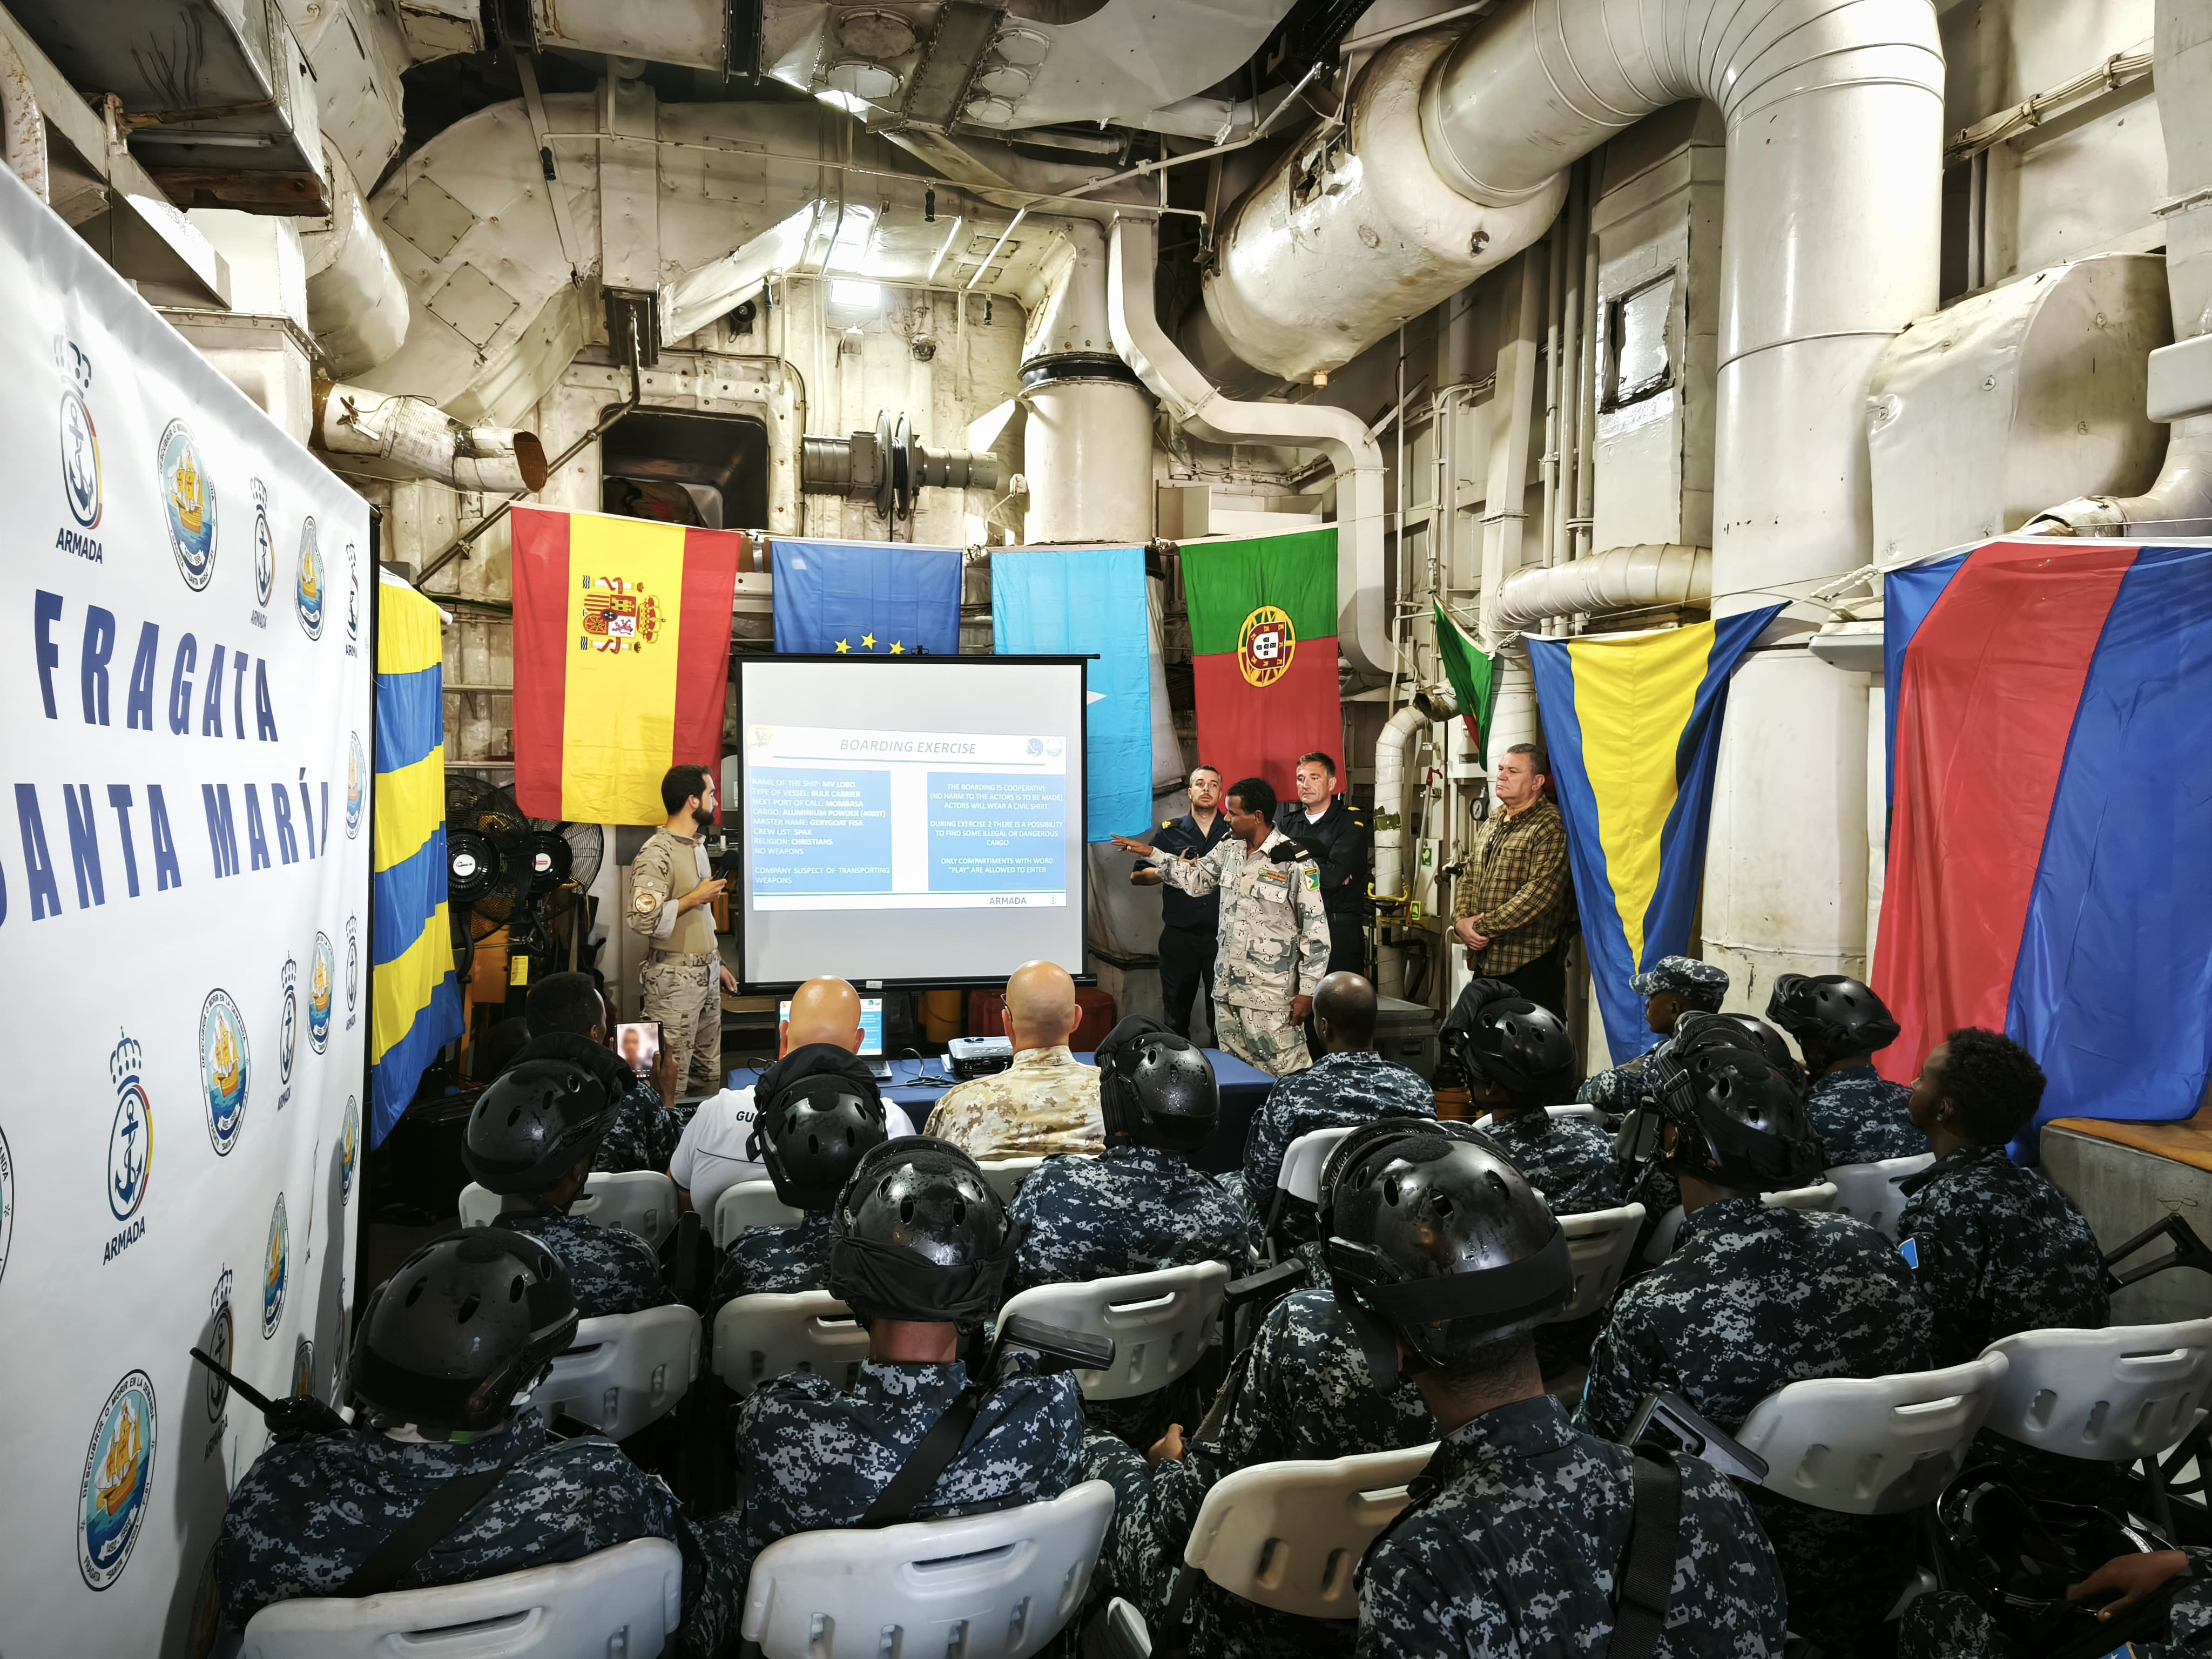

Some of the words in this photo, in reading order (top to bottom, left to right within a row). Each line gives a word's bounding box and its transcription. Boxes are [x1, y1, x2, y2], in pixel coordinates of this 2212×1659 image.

[56, 527, 103, 564] ARMADA
[250, 609, 267, 631] ARMADA
[34, 589, 279, 742] FRAGATA
[840, 739, 913, 753] BOARDING
[917, 741, 977, 754] EXERCISE
[0, 783, 182, 928] ANTA
[989, 897, 1027, 905] ARMADA
[103, 1216, 145, 1266] ARMADA
[82, 1420, 104, 1498] DESCUBRIR
[105, 1407, 110, 1417] O
[111, 1380, 129, 1407] MORIR
[129, 1376, 137, 1387] EN
[137, 1377, 143, 1388] LA
[143, 1381, 154, 1423] DEMANDA
